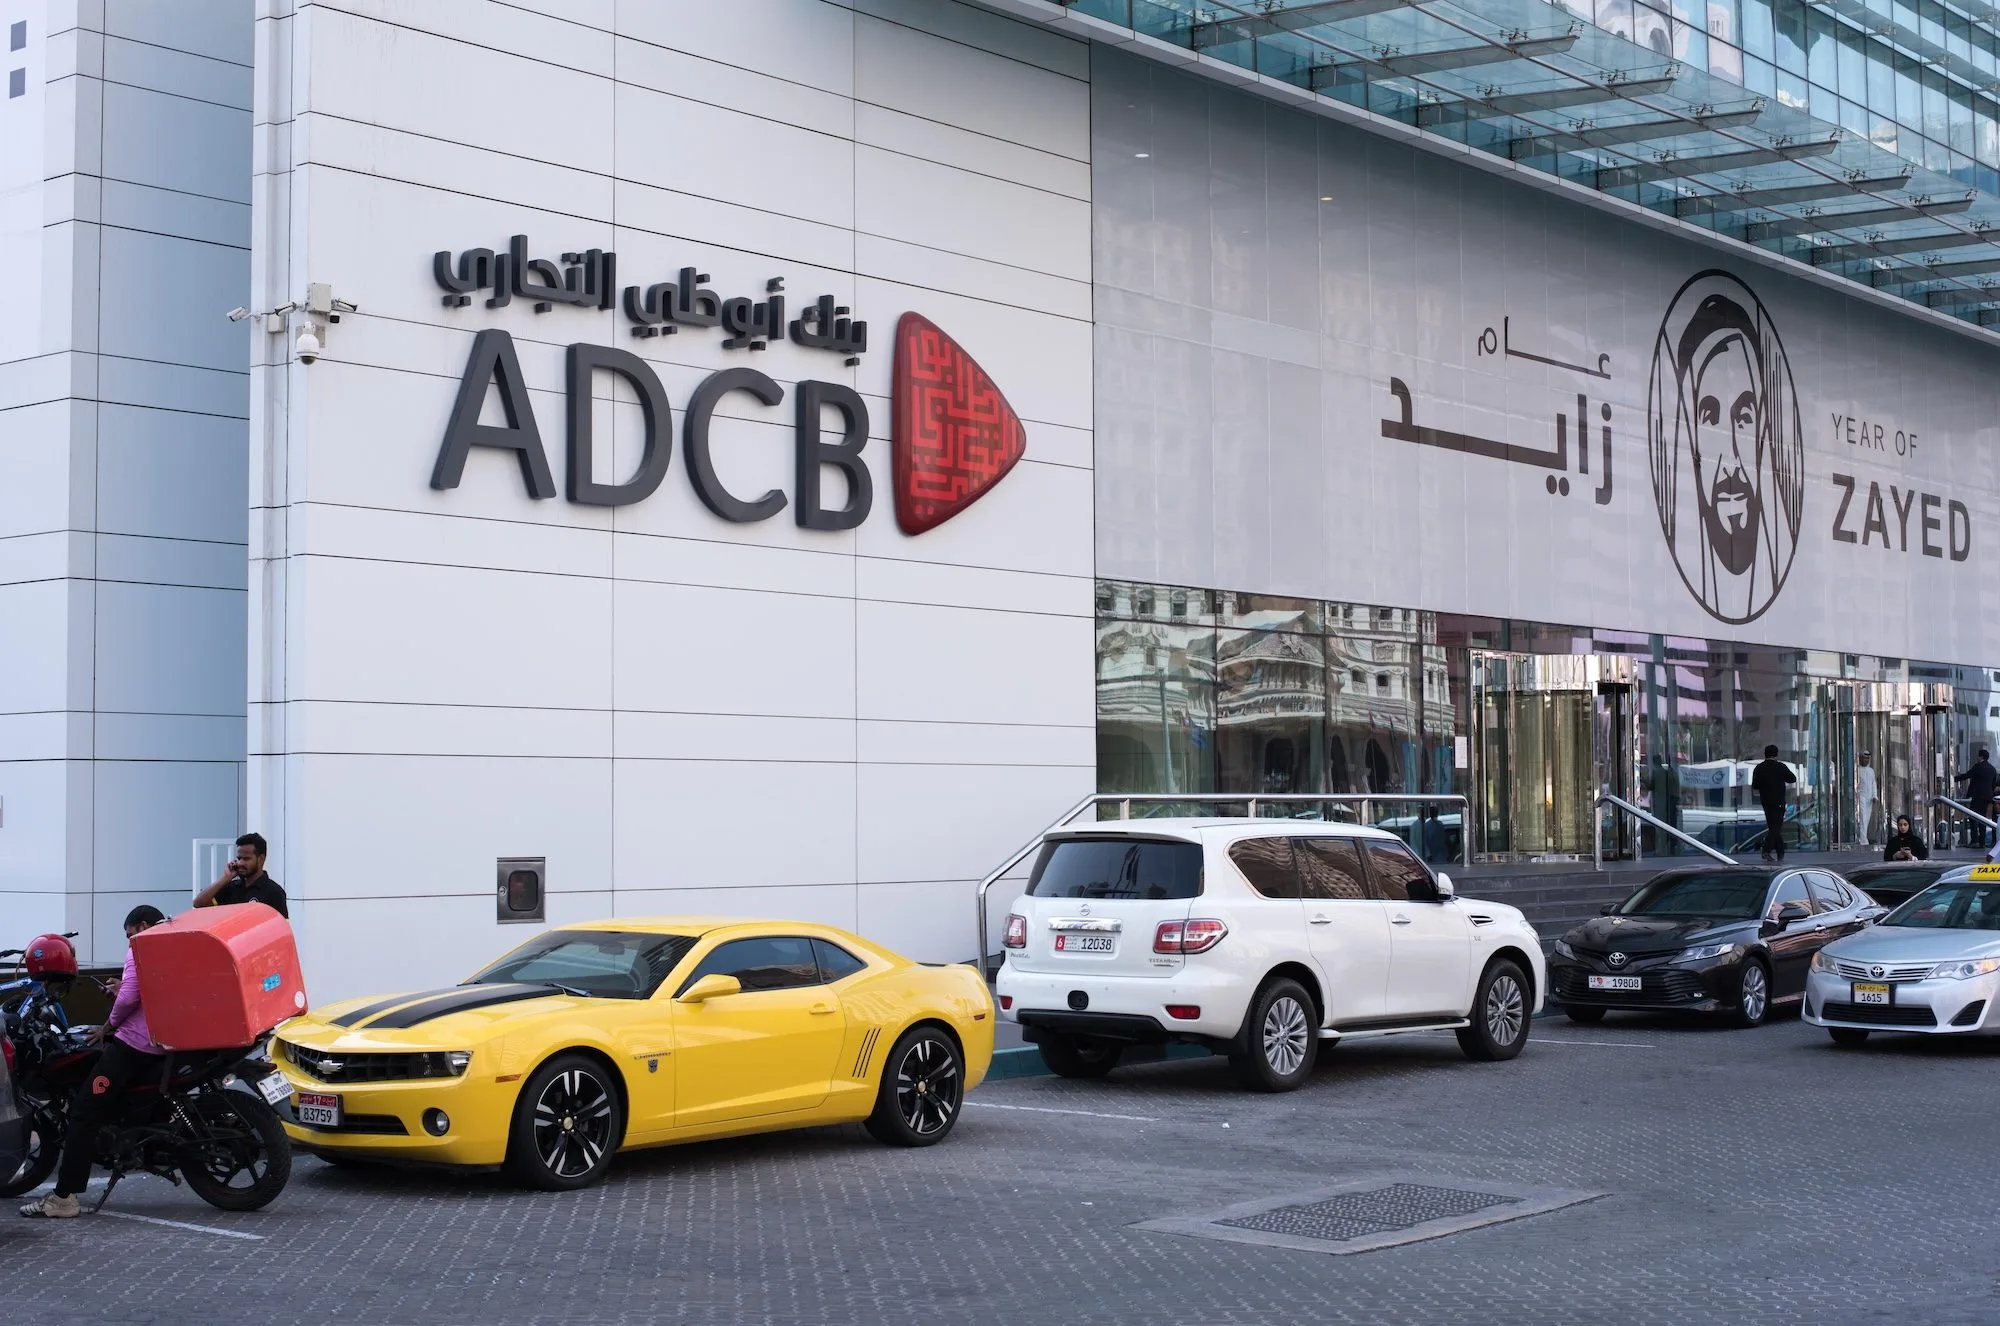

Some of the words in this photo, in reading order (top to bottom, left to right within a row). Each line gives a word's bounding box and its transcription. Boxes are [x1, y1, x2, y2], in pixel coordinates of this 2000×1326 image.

[433, 234, 616, 312] التجاري
[790, 294, 867, 366] بنك
[1478, 315, 1611, 380] عام
[430, 328, 873, 531] ADCB
[1381, 376, 1613, 505] زايد
[1831, 412, 1885, 452] YEAR
[1894, 429, 1918, 458] OF
[1831, 472, 1972, 562] ZAYED
[1081, 937, 1112, 951] 12038
[1612, 978, 1639, 988] 19808
[1861, 993, 1882, 1003] 1615
[303, 1107, 332, 1123] 83759
[313, 1095, 322, 1106] 17
